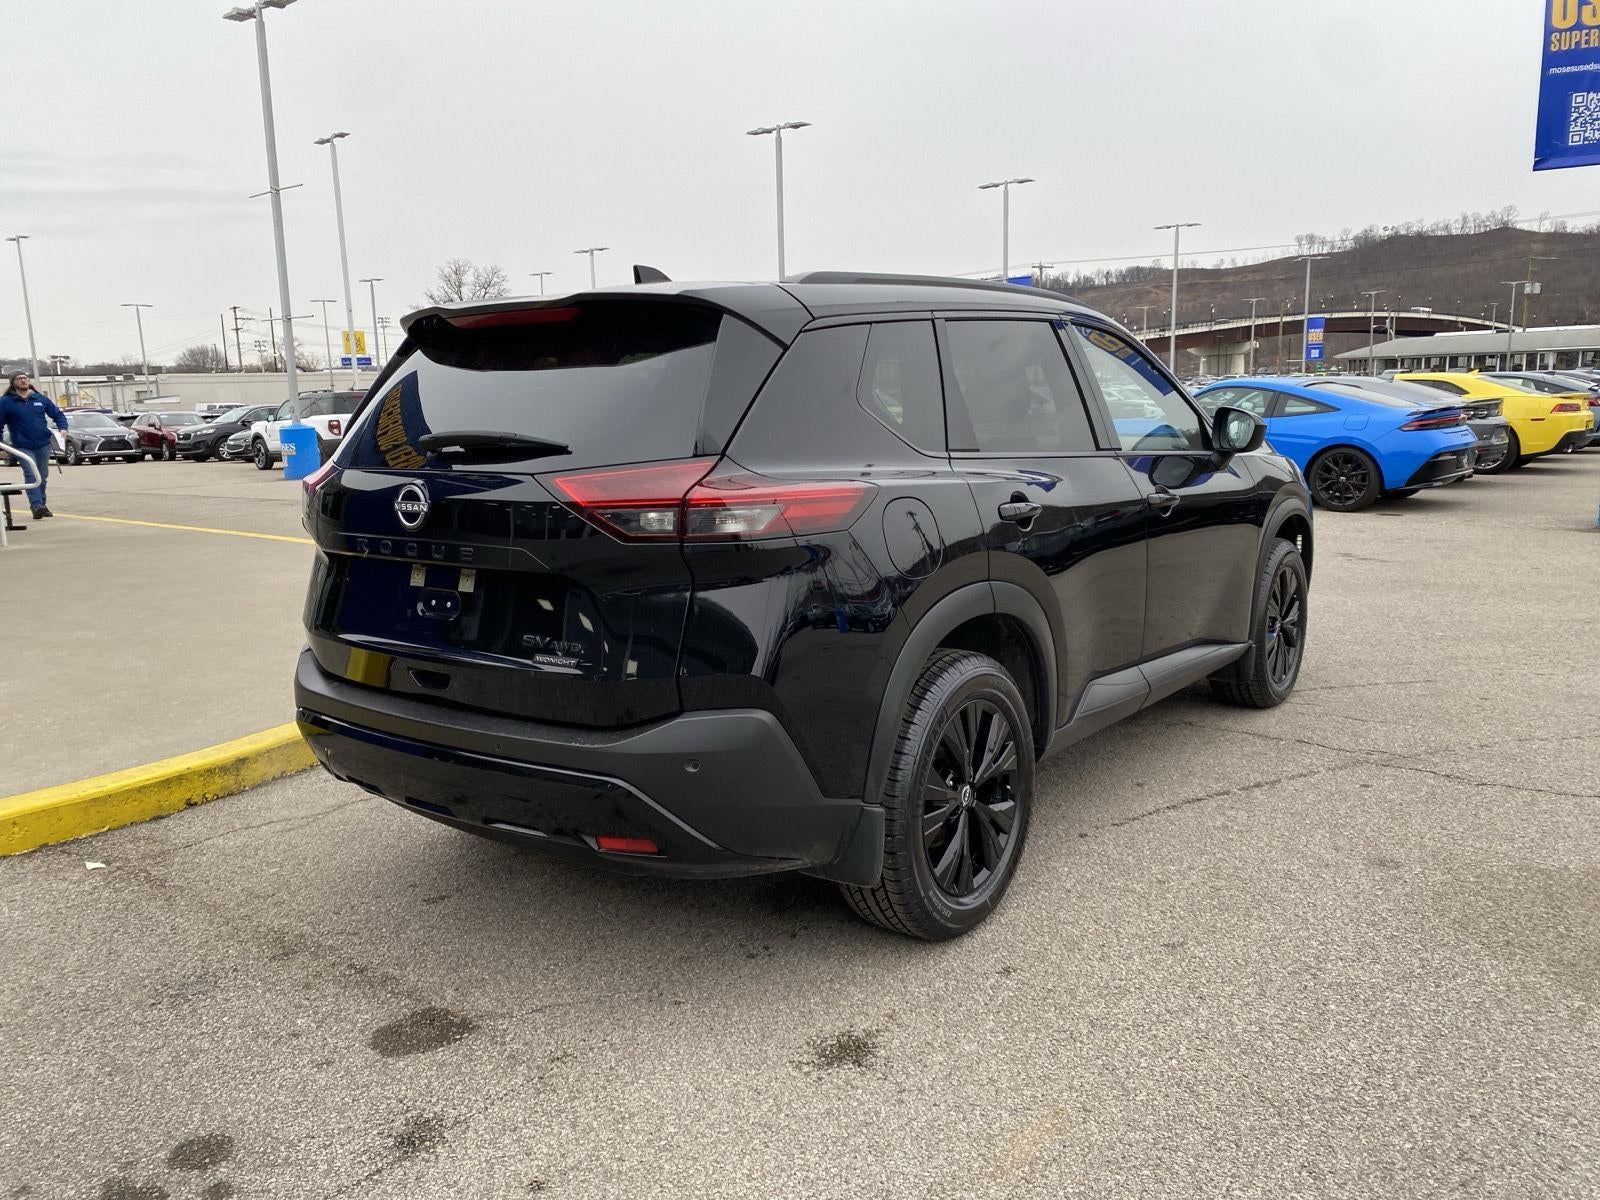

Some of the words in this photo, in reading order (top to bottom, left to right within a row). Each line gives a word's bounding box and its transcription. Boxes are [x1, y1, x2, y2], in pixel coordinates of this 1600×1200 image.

[1551, 29, 1599, 51] SUPER
[395, 502, 427, 512] NISSAN
[357, 538, 474, 560] ROGUE
[522, 635, 550, 648] SV
[535, 655, 576, 666] MIDNIGHT
